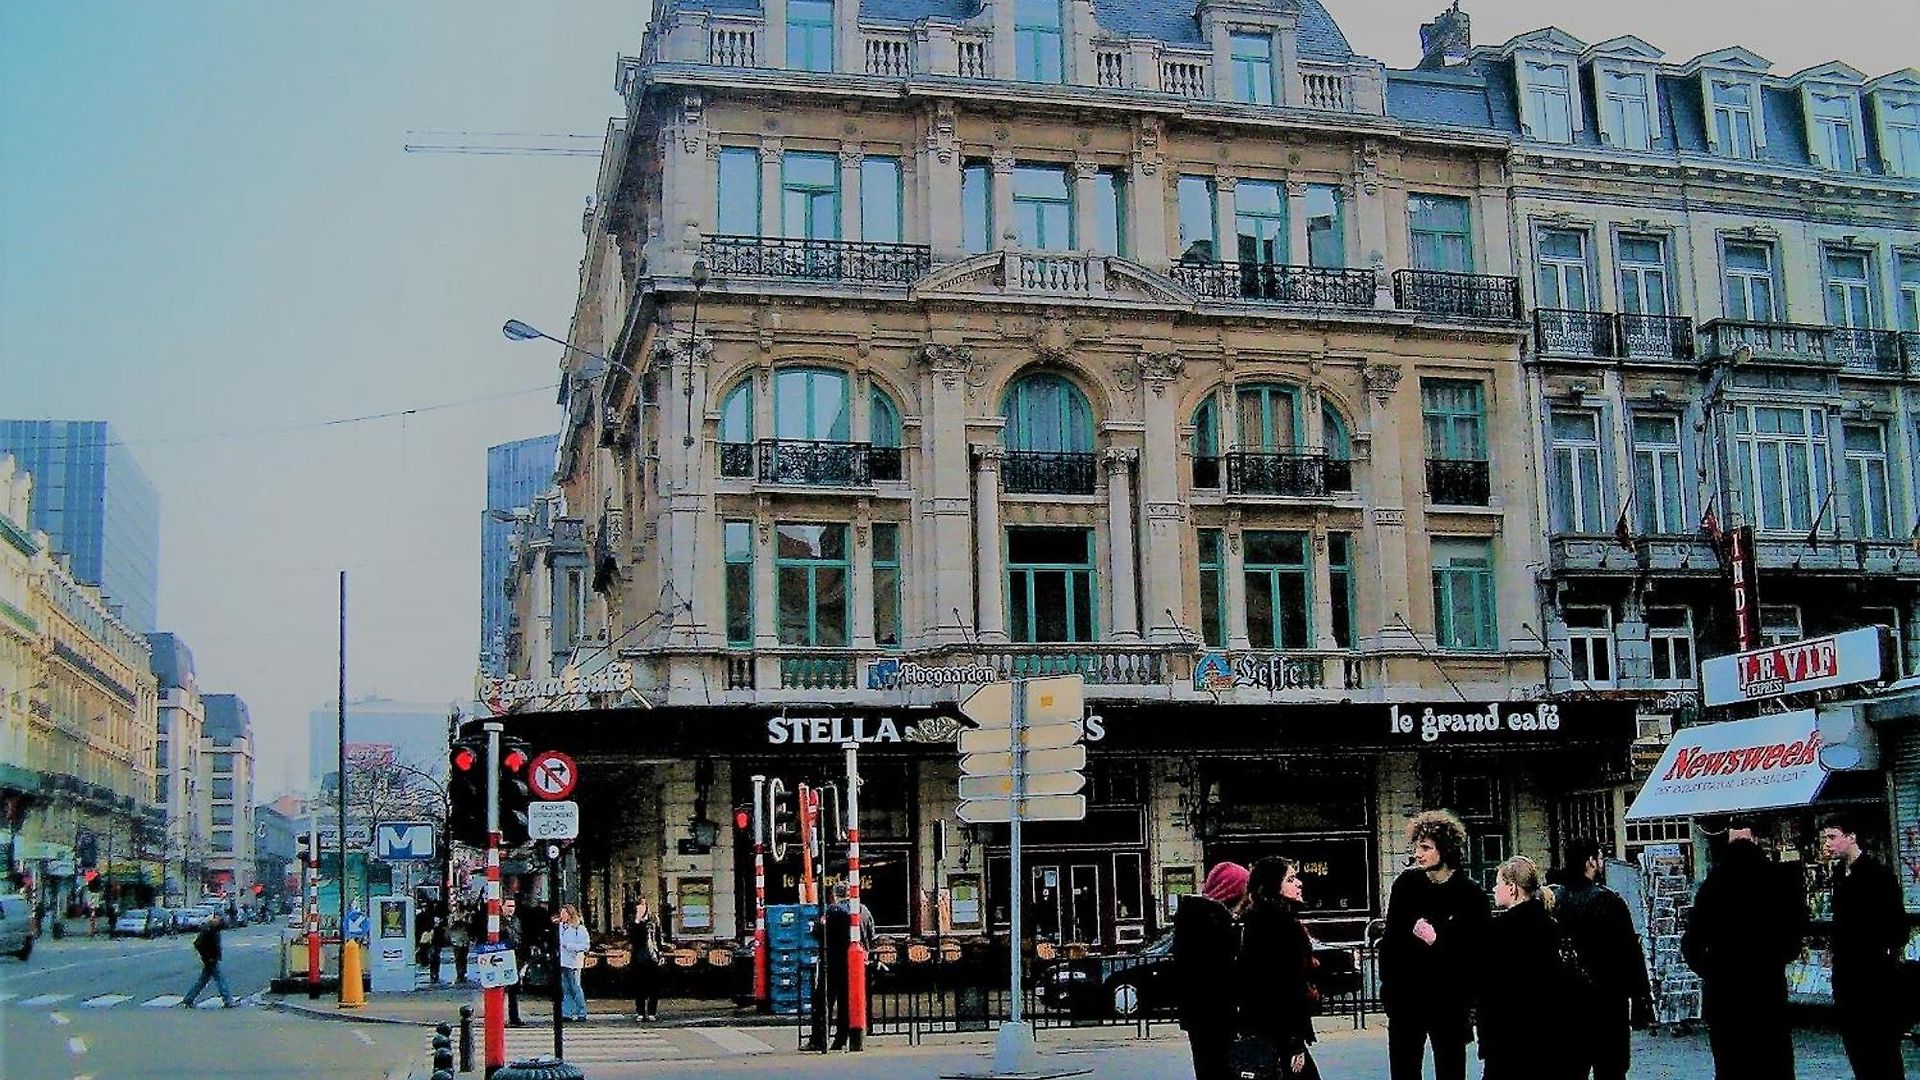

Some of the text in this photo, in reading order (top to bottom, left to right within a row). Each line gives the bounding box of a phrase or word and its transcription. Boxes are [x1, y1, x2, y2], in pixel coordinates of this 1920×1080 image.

[903, 664, 996, 686] Hoegaarden
[1738, 639, 1836, 691] LE VIF
[767, 717, 902, 744] STELLA
[1389, 702, 1561, 742] le grand café
[1662, 730, 1823, 782] Newsweek
[380, 826, 433, 856] M
